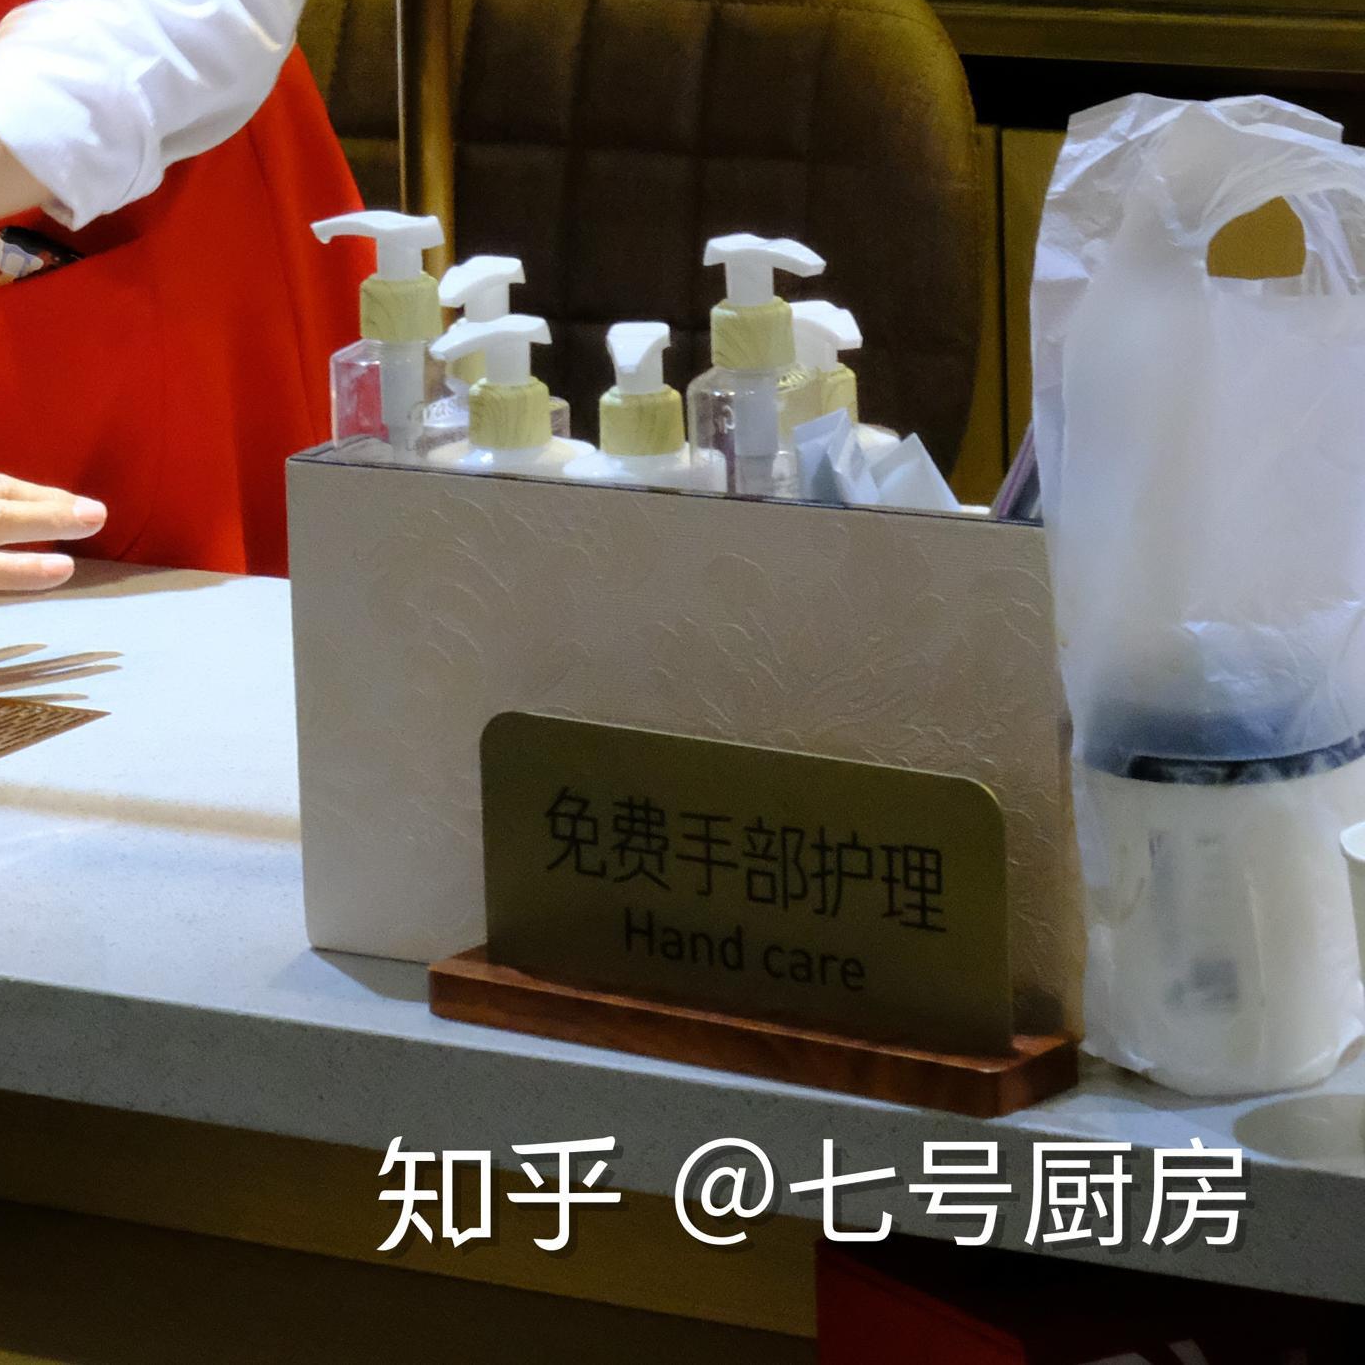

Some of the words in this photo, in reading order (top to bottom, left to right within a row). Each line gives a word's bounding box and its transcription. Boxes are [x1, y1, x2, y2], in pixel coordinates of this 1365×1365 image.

[543, 785, 948, 934] 免费手部护理
[622, 907, 745, 972] Hand
[761, 940, 867, 992] care
